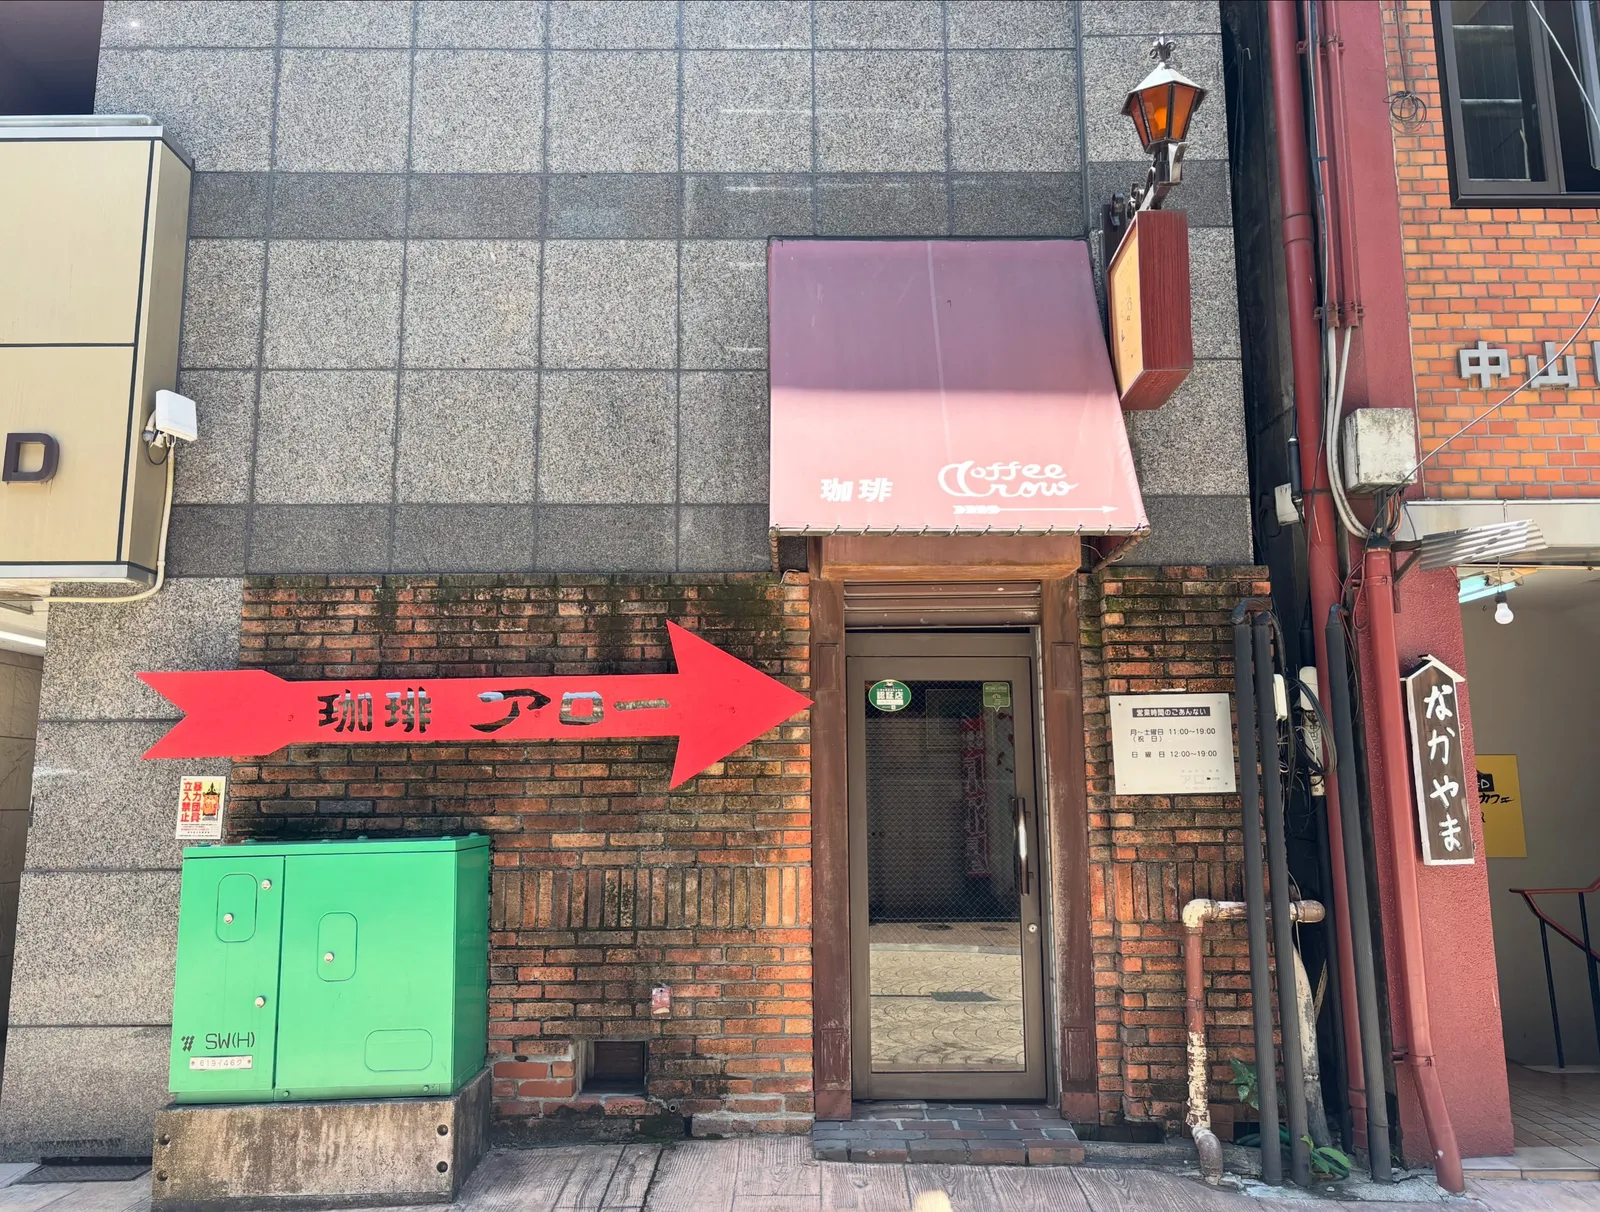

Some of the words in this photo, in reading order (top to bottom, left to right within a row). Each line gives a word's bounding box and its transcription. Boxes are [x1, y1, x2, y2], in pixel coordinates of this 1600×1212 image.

[1459, 341, 1600, 389] 中山
[2, 433, 60, 483] D
[938, 460, 1067, 498] Coffee
[820, 478, 893, 503] 珈琲
[317, 686, 432, 733] 珈琲
[469, 688, 671, 733] アロー
[1423, 684, 1462, 852] なかやま
[180, 781, 193, 823] 立入禁止
[205, 1031, 255, 1050] SW(H)
